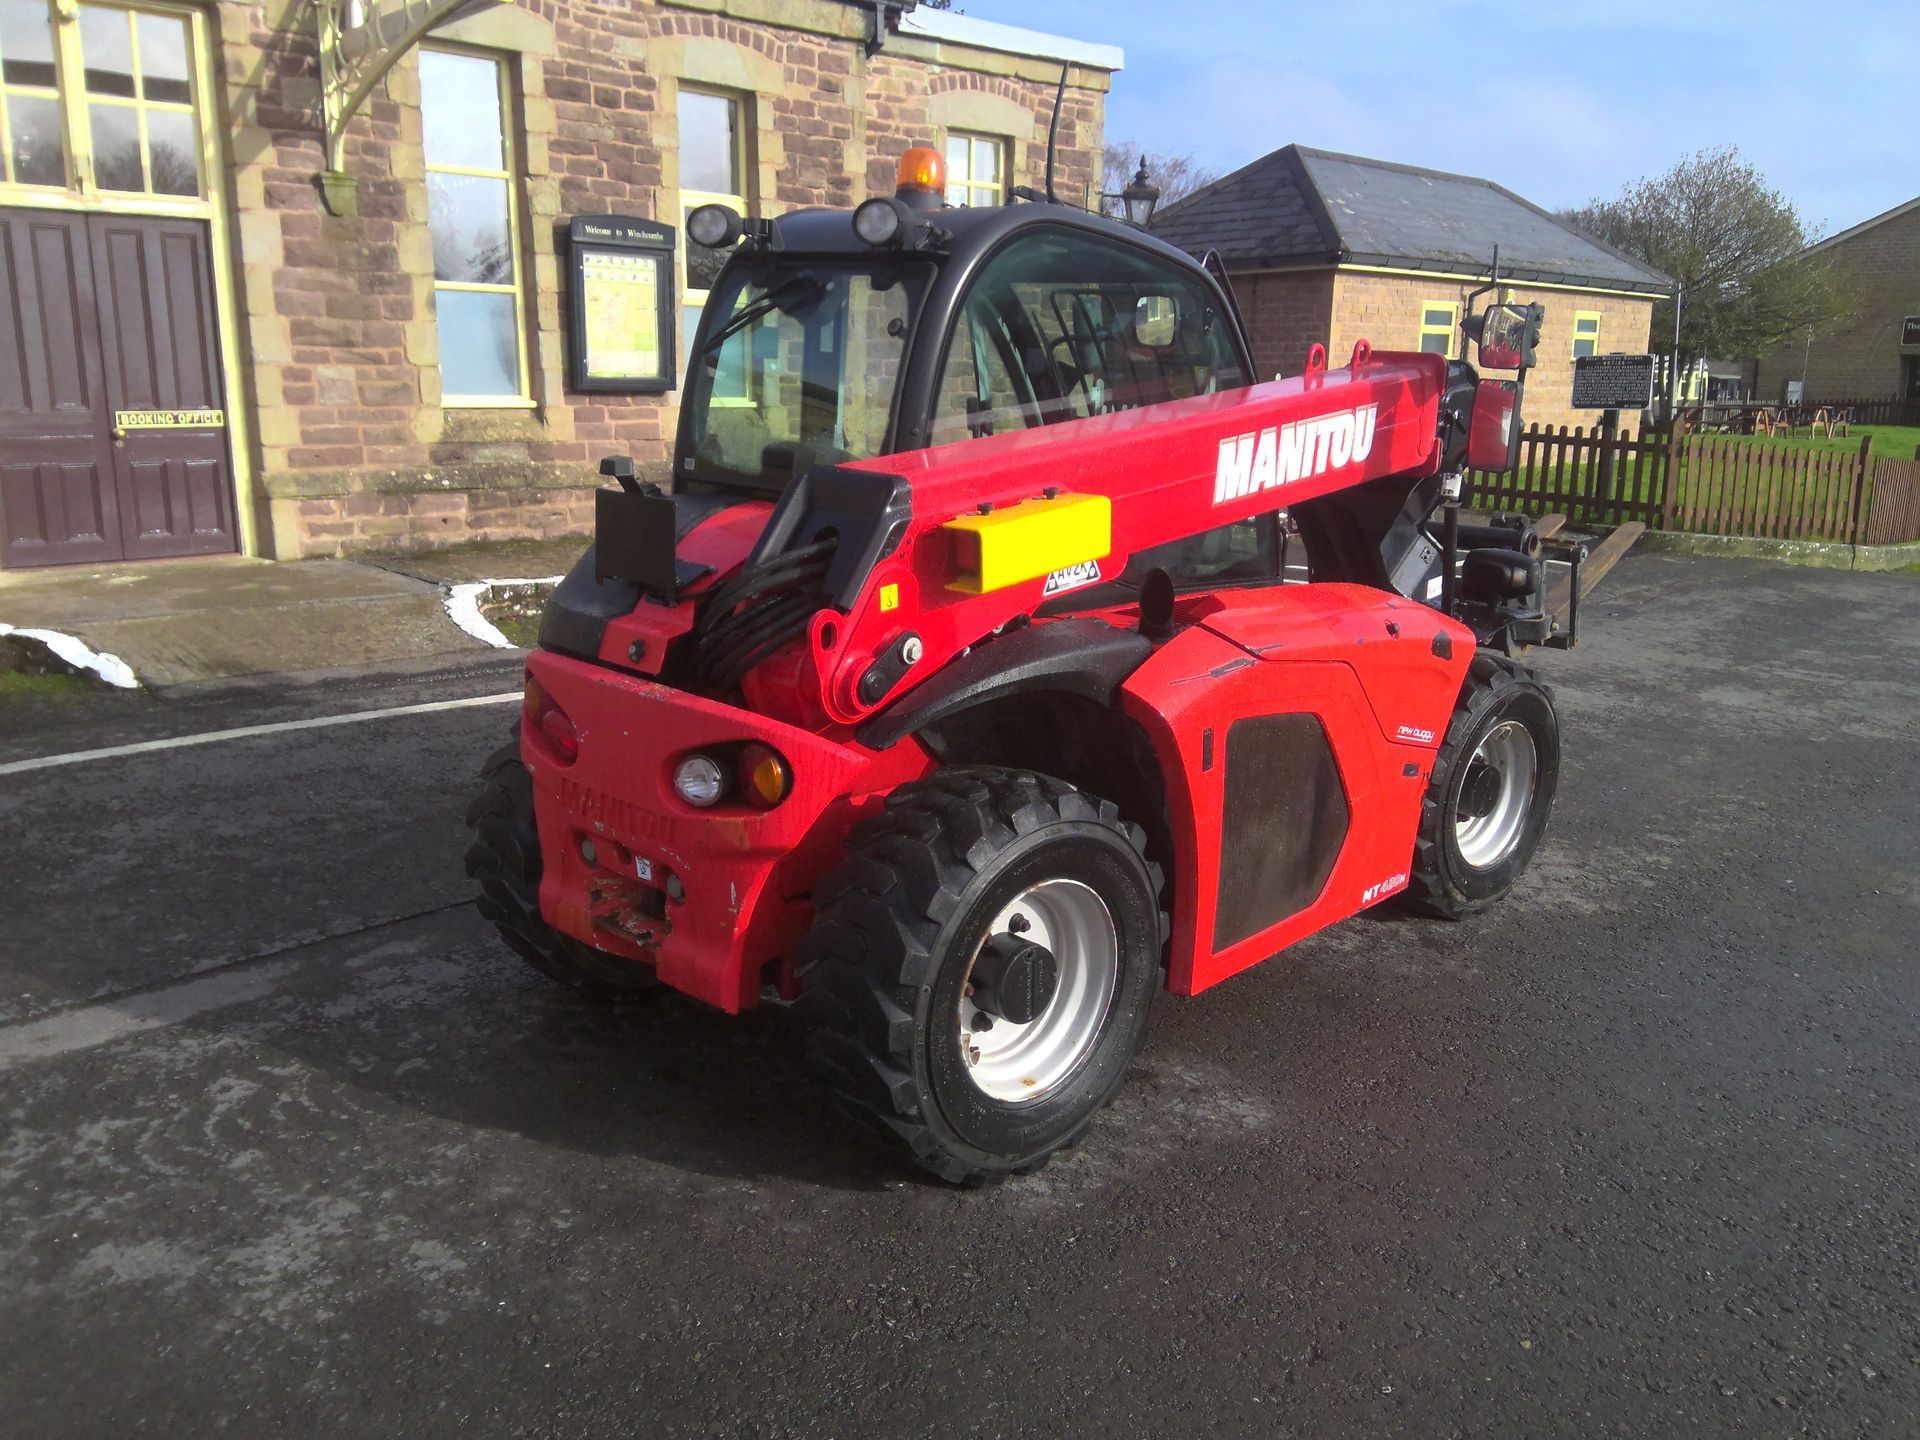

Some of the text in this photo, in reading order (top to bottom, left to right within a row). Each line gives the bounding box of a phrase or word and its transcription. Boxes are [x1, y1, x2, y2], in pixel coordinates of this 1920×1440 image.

[585, 225, 611, 236] Welcome
[121, 413, 219, 425] BOOKING OFFICE
[1212, 402, 1378, 508] MANITOU
[1397, 725, 1413, 735] new
